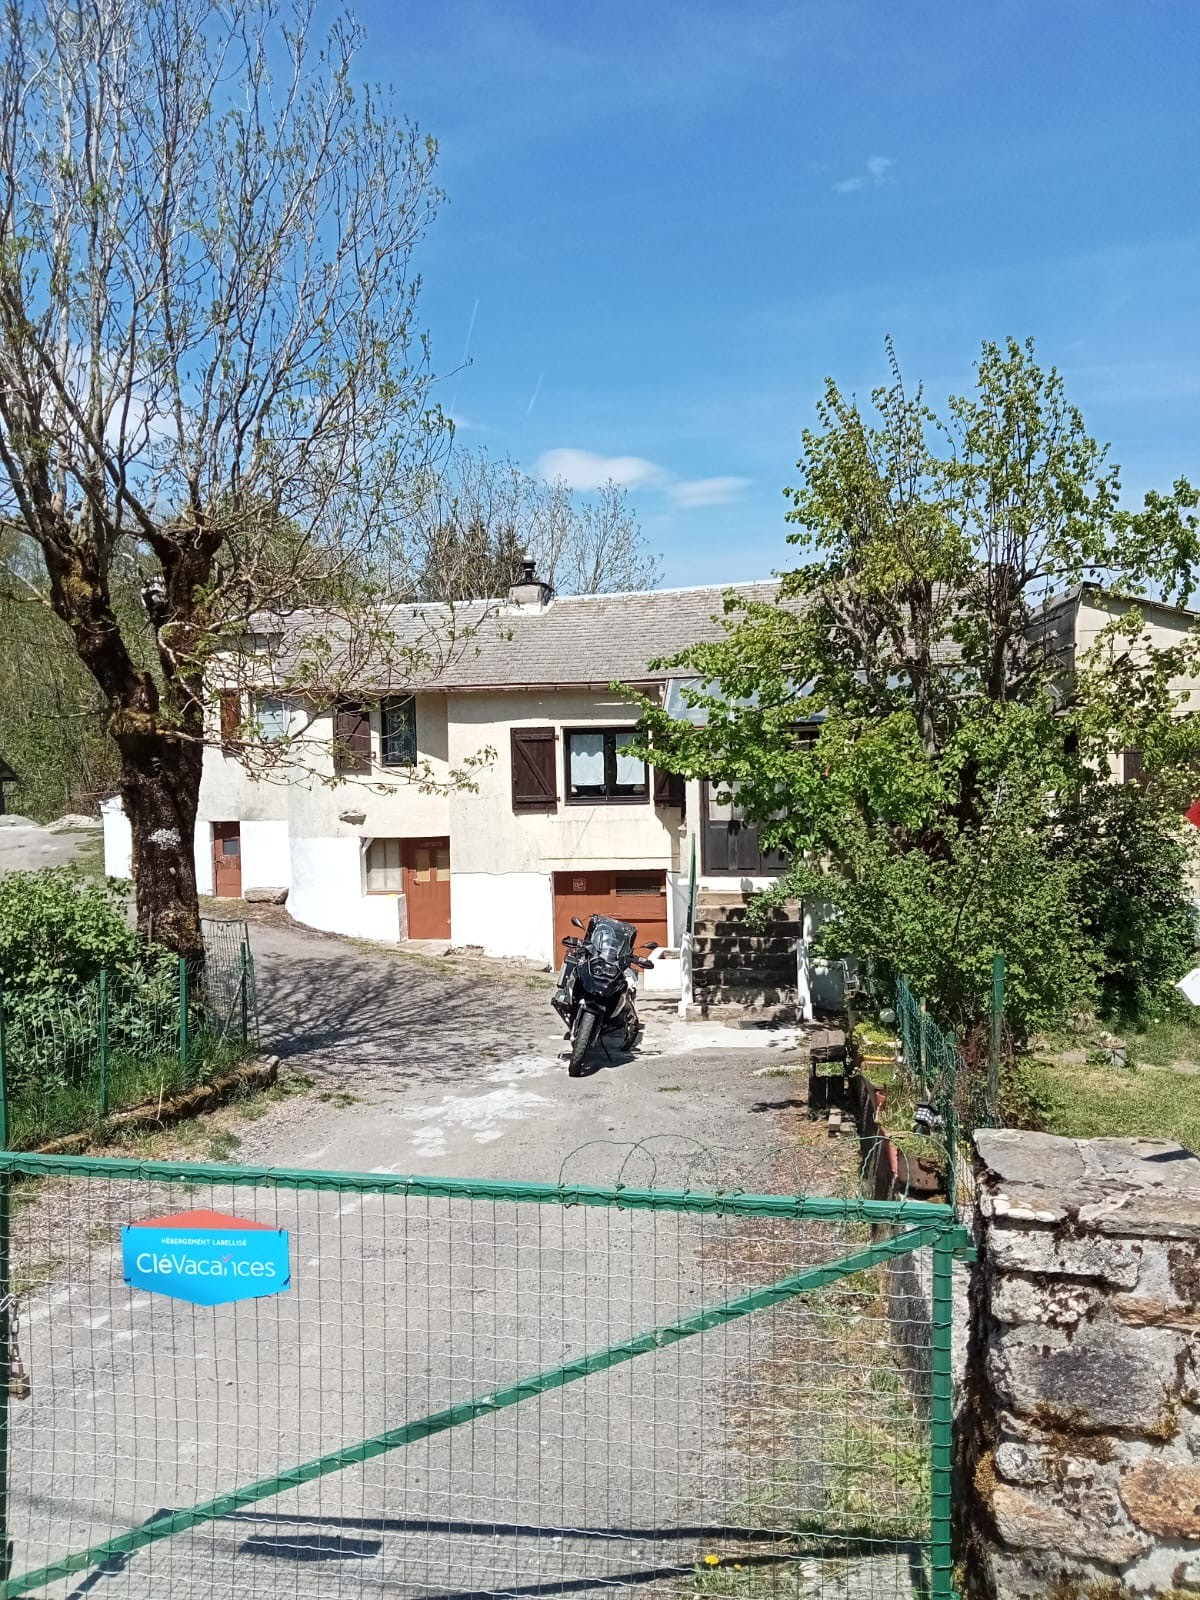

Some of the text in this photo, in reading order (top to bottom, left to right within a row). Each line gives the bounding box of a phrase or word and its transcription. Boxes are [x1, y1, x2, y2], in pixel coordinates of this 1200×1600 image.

[161, 1237, 247, 1247] HÉBERGEMENT LABELLISÉ
[136, 1253, 276, 1277] CléVacances
